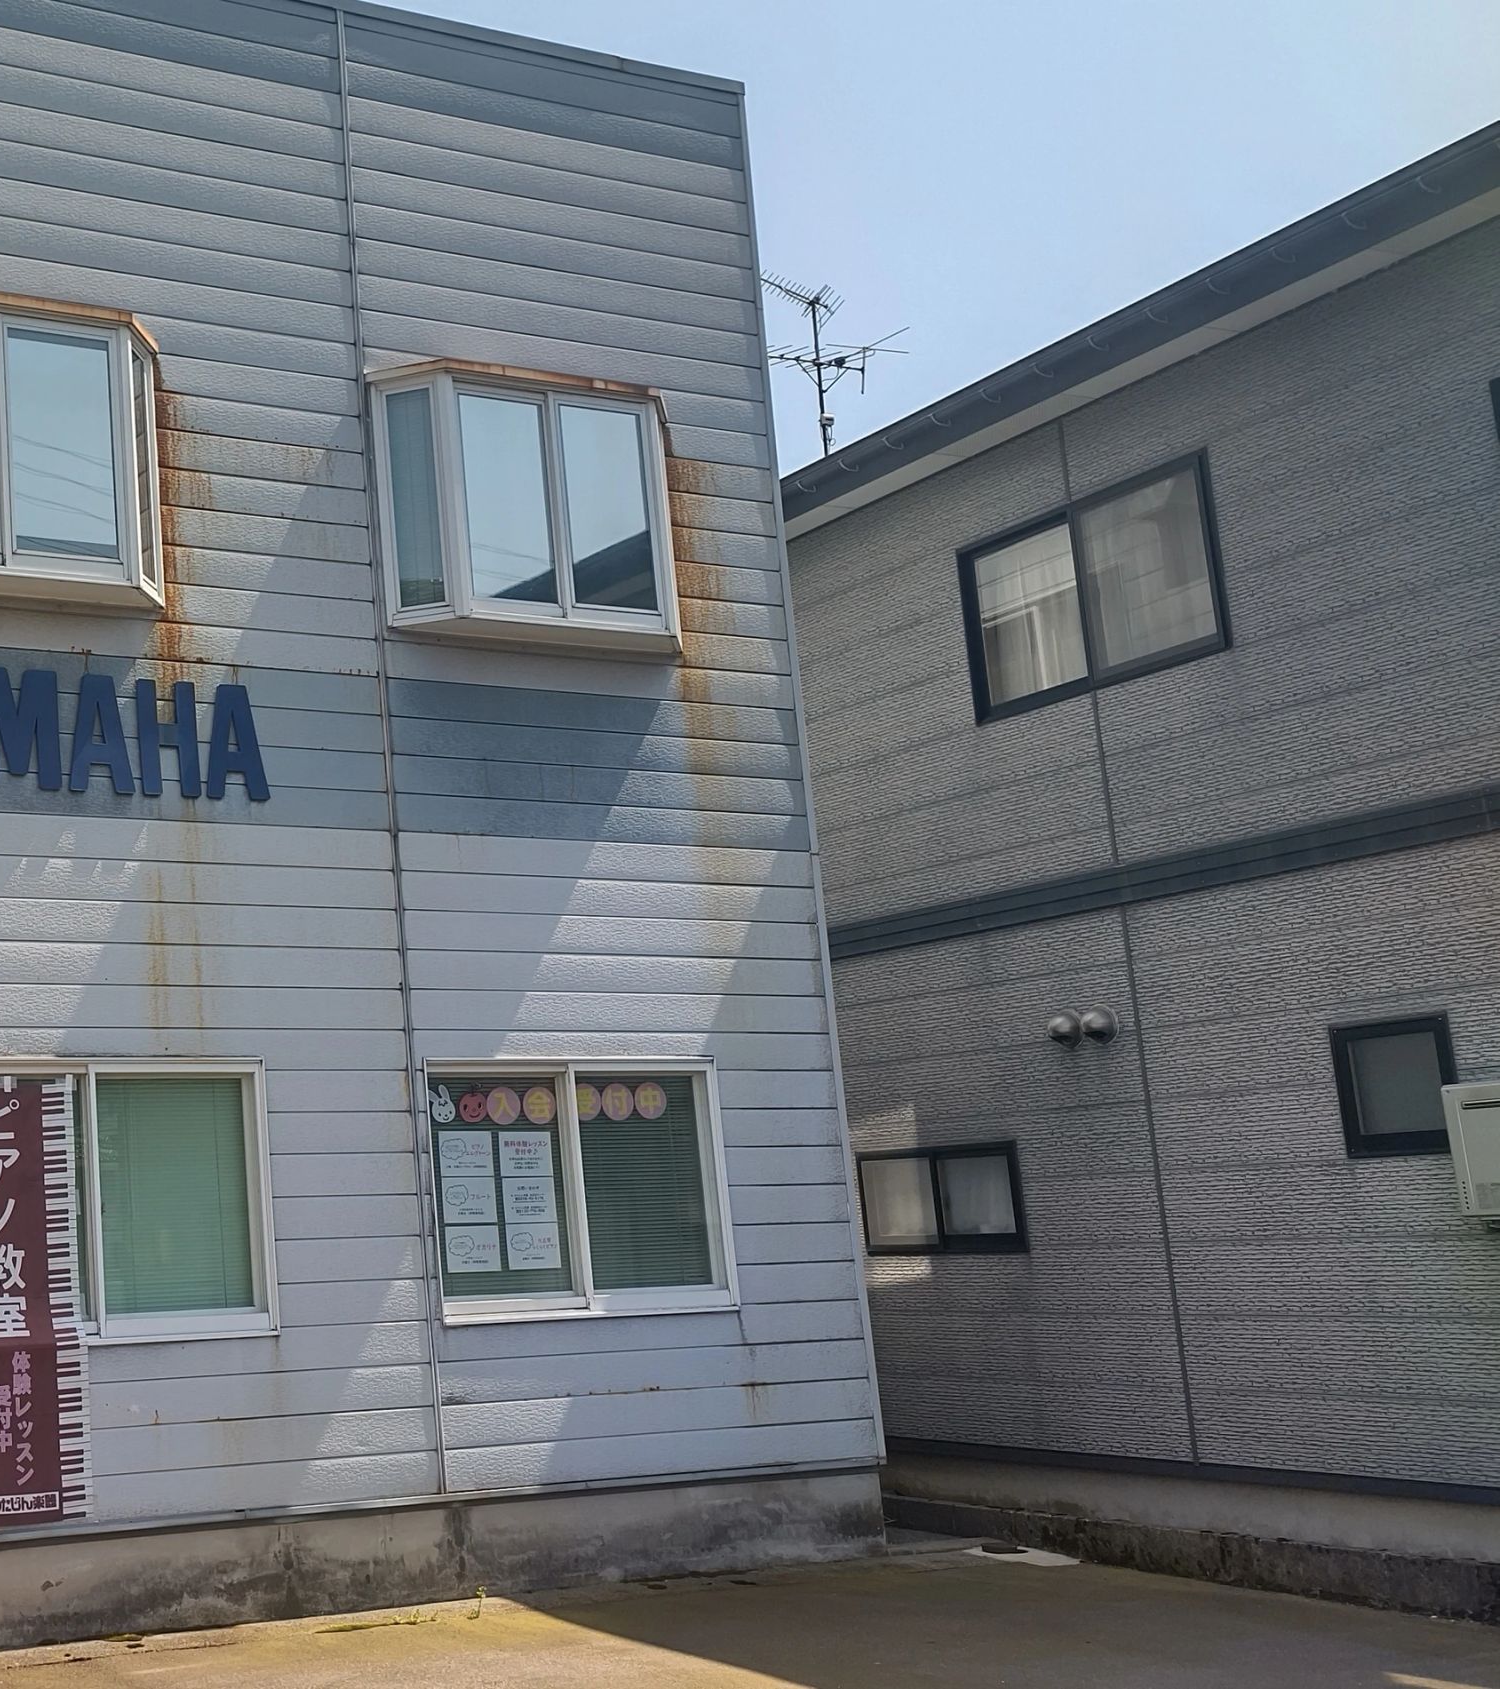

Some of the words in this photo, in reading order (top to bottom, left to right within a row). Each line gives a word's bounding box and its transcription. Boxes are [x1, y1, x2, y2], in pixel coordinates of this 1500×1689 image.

[11, 1350, 35, 1486] 体験レッスン
